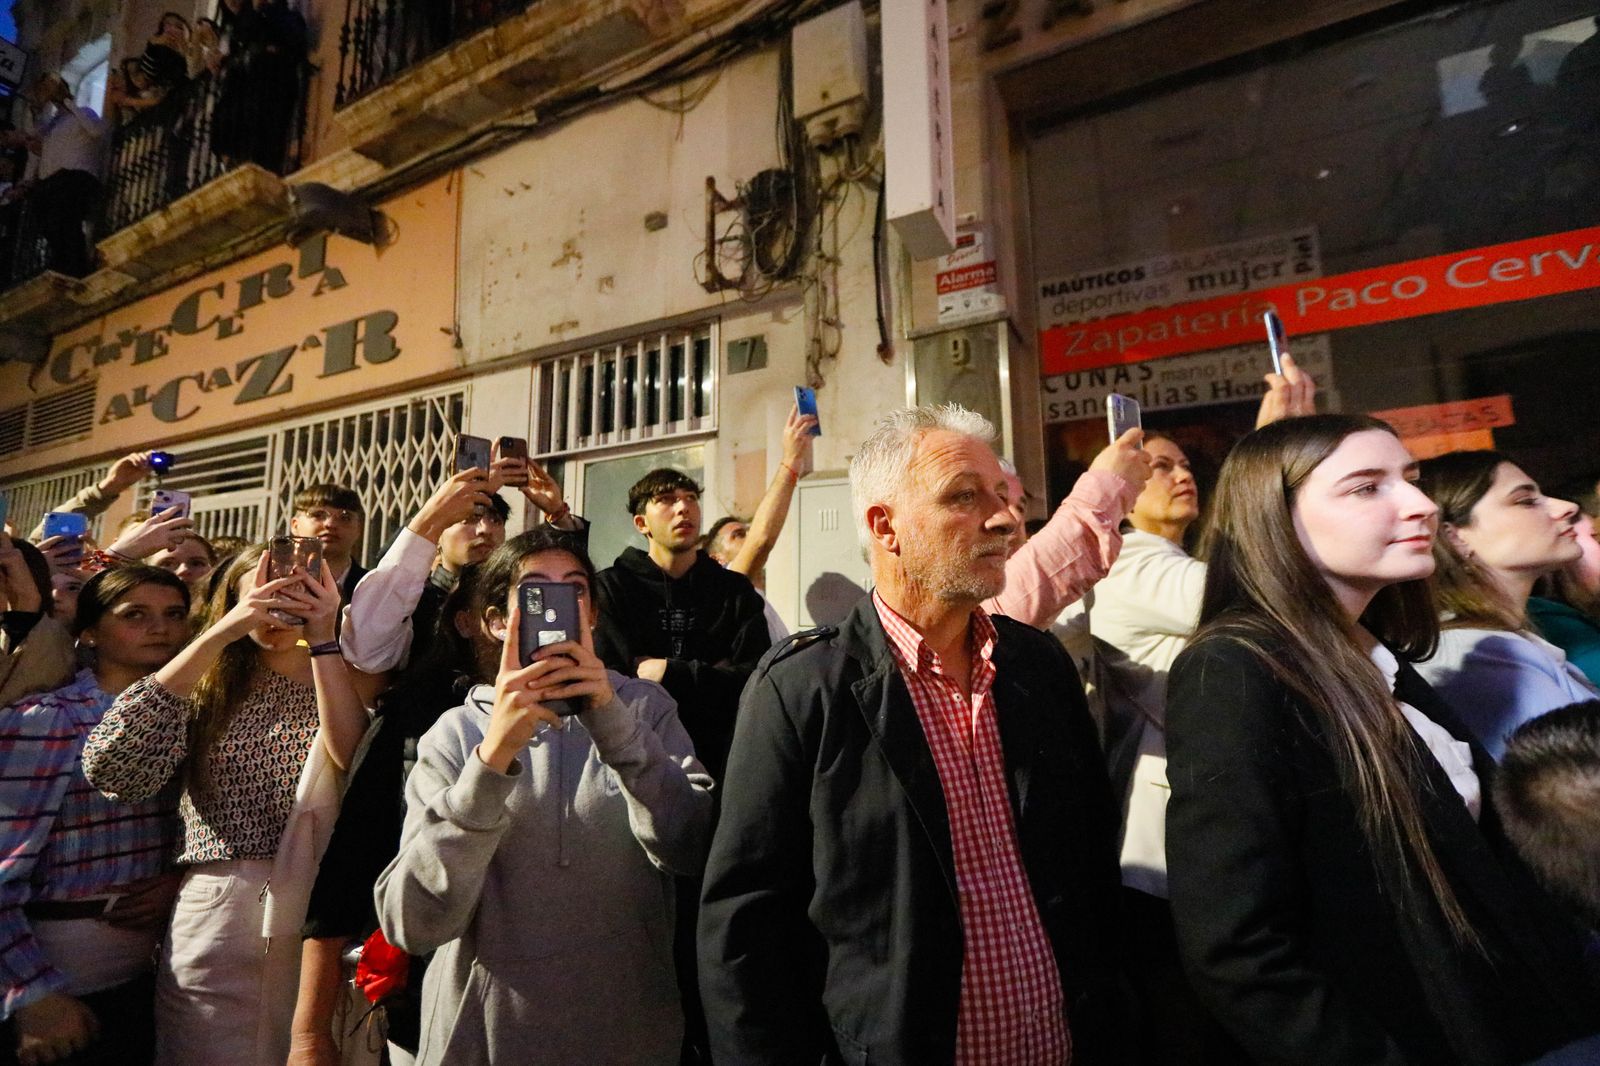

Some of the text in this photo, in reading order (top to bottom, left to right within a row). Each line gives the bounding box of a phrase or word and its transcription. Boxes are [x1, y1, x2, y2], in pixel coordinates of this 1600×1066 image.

[940, 266, 995, 287] Alarma
[1053, 259, 1284, 316] deportivas mujer
[1296, 274, 1428, 317] Paco
[1445, 244, 1600, 289] Cerv
[98, 309, 402, 425] ALCAZAR
[738, 336, 757, 369] 7
[949, 336, 971, 367] 9
[1048, 383, 1198, 420] sanlias
